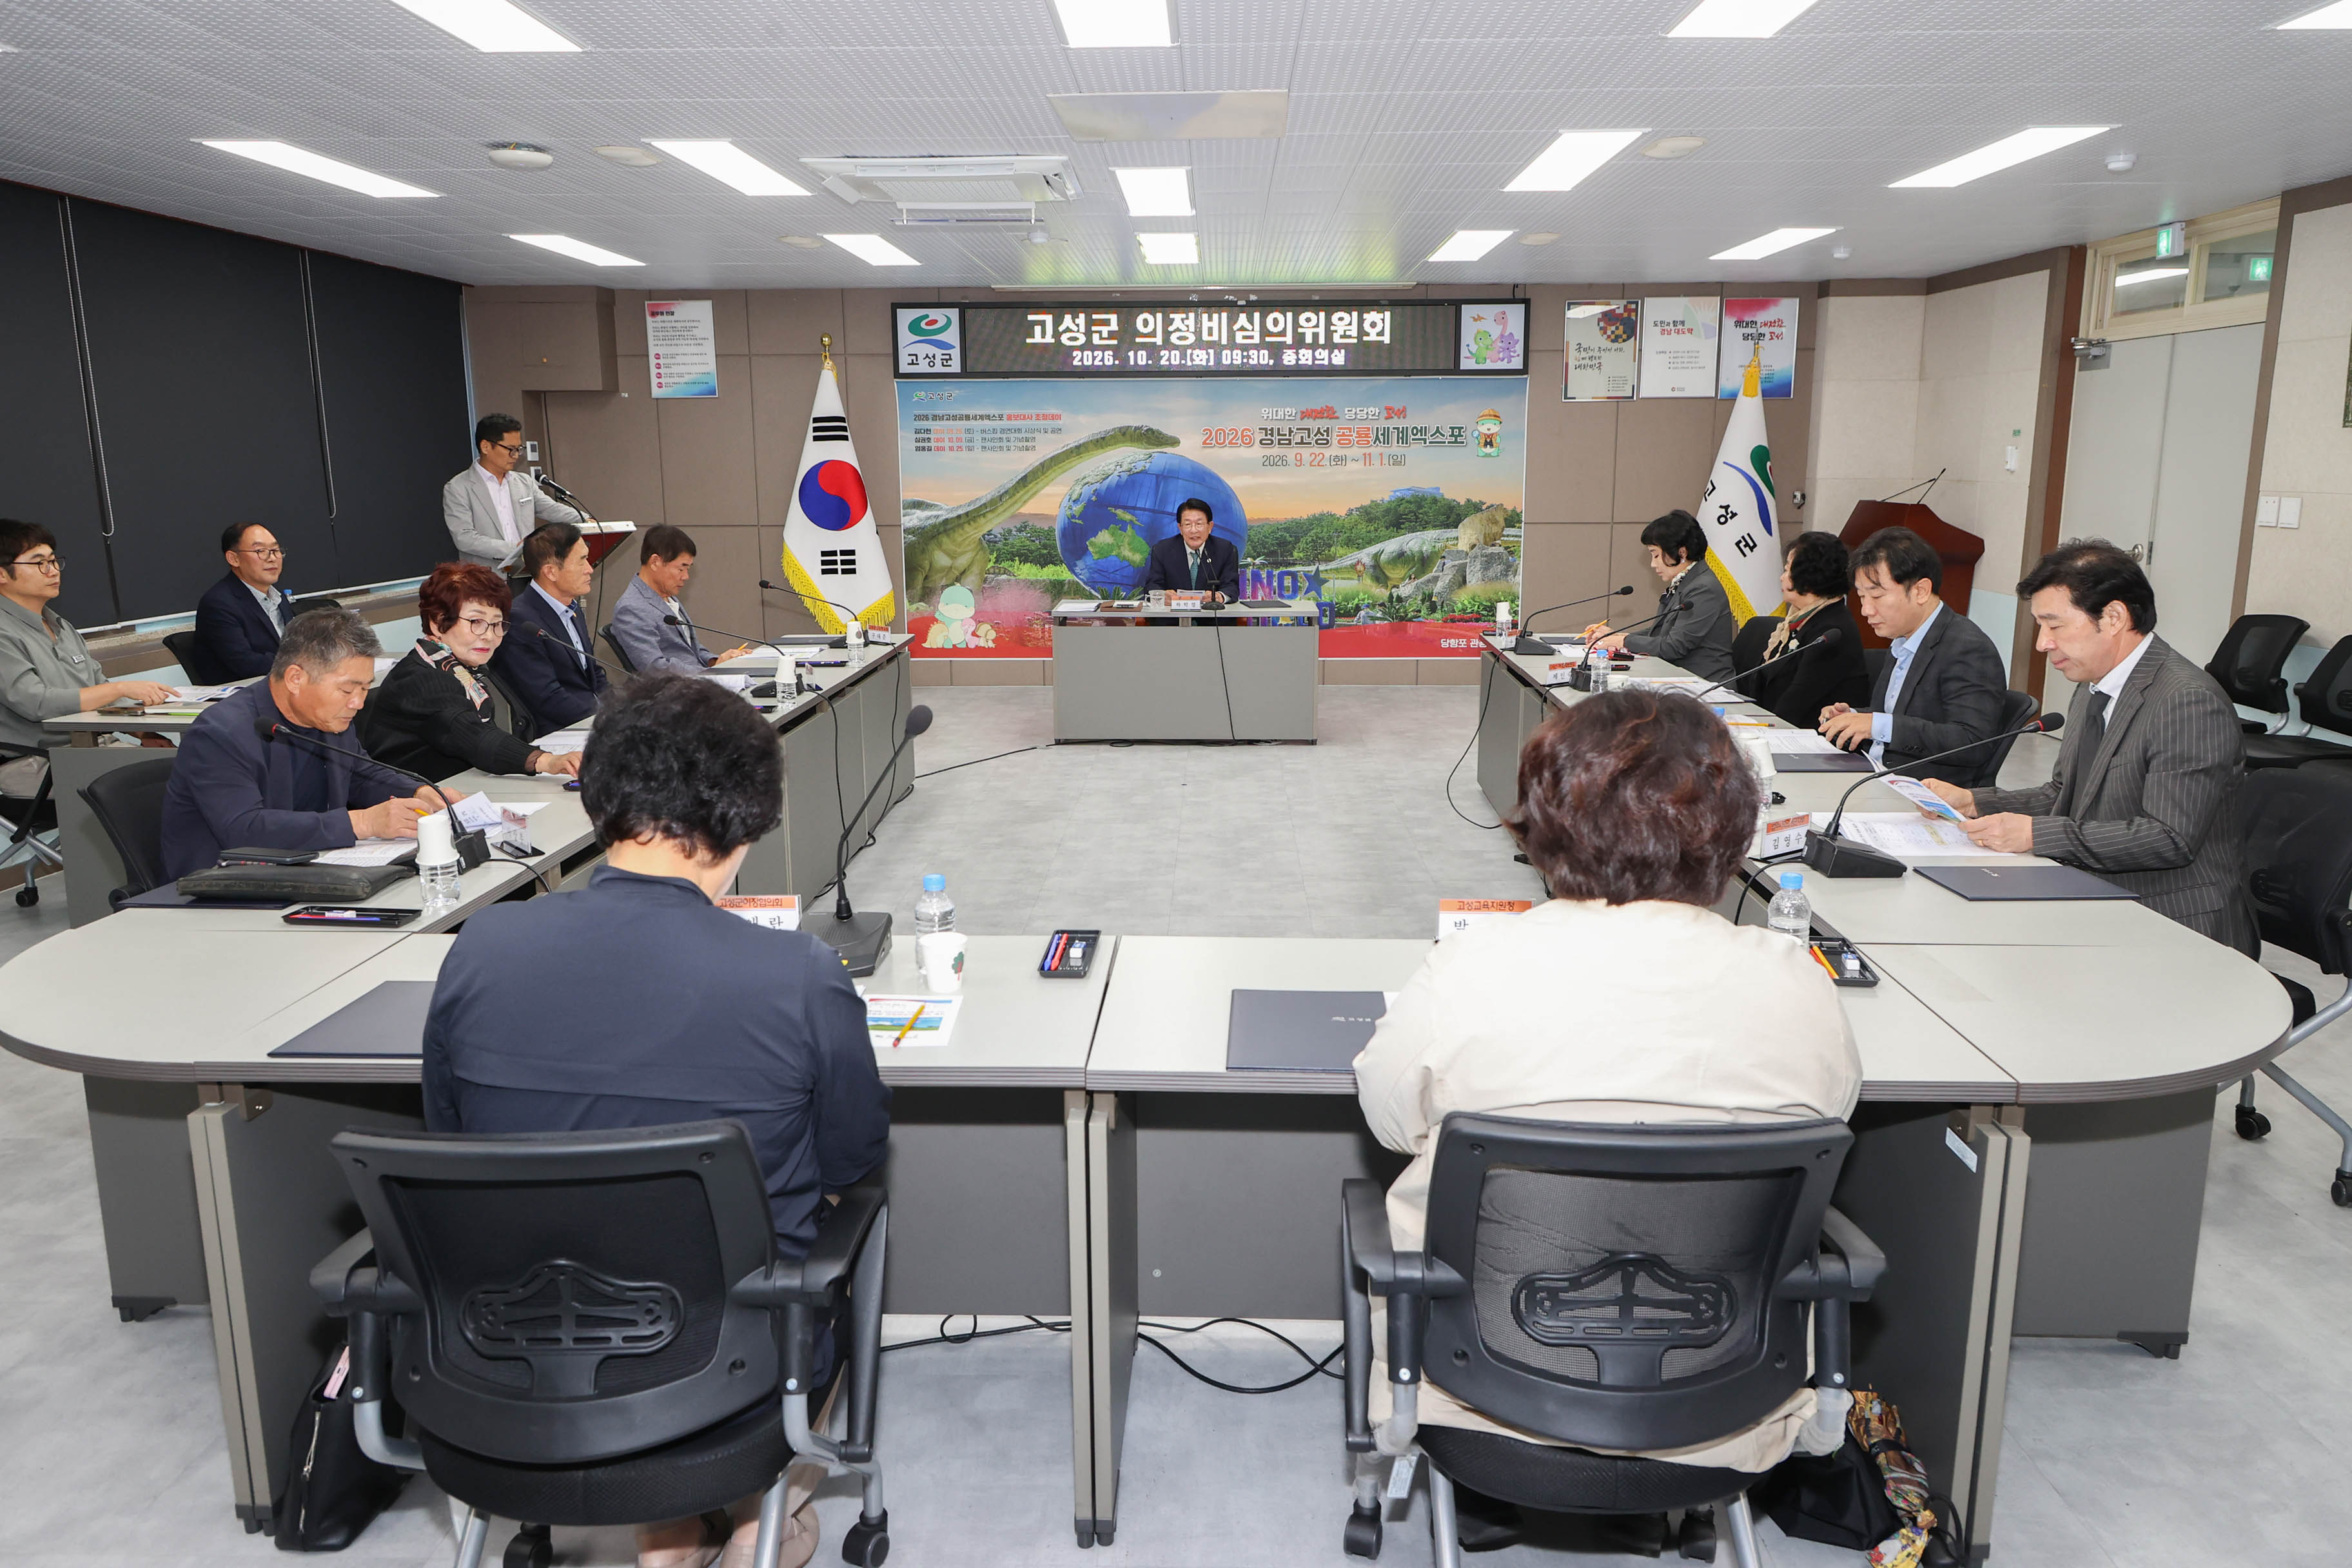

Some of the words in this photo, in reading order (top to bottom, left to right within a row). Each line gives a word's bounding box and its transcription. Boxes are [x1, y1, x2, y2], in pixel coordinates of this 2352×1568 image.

[1026, 311, 1119, 346] 고성군
[1135, 310, 1391, 346] 의정비심의위원회
[1734, 320, 1757, 328] 위대한
[907, 353, 953, 367] 고성군
[1073, 350, 1119, 366] 2026.
[1128, 350, 1152, 366] 10.
[1222, 349, 1274, 366] 09:30,
[928, 392, 953, 400] 고성군
[1261, 407, 1297, 420] 위대한
[1344, 407, 1380, 420] 당당한
[1201, 427, 1253, 447] 2026
[1258, 426, 1331, 447] 경남고성
[1335, 425, 1465, 447] 공룡세계엑스포
[1262, 455, 1290, 467] 2026.
[1295, 453, 1304, 467] 9.
[1362, 453, 1375, 467] 11.
[1440, 638, 1467, 648] 당항포
[1456, 901, 1515, 910] 고성교육지원청
